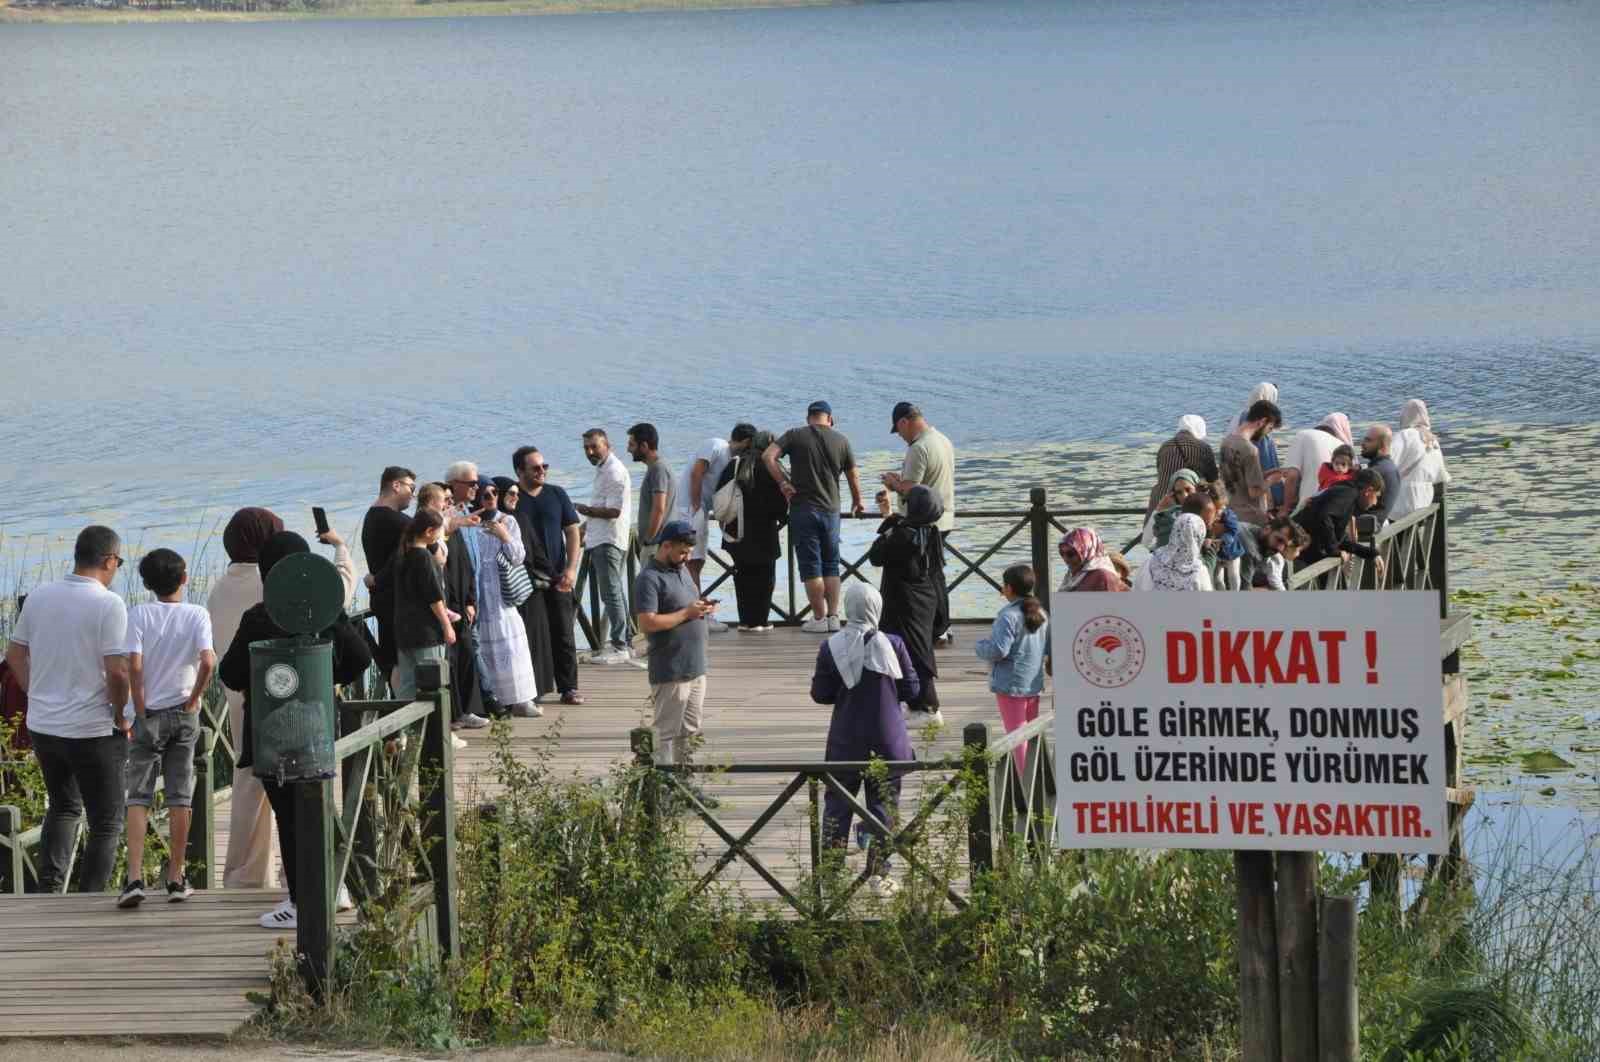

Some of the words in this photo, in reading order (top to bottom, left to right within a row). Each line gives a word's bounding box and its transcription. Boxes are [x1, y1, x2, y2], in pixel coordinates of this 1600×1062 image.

[1166, 619, 1346, 684] DİKKAT
[1364, 630, 1378, 684] !
[1077, 701, 1149, 737] GÖLE
[1159, 701, 1279, 741] GİRMEK,
[1290, 707, 1419, 743] DONMUŞ
[1070, 746, 1126, 782] GÖL
[1134, 745, 1276, 782] ÜZERİNDE
[1285, 747, 1429, 784] YÜRÜMEK
[1072, 795, 1218, 834] TEHLİKELİ
[1229, 803, 1264, 835] VE
[1274, 803, 1432, 837] YASAKTIR.
